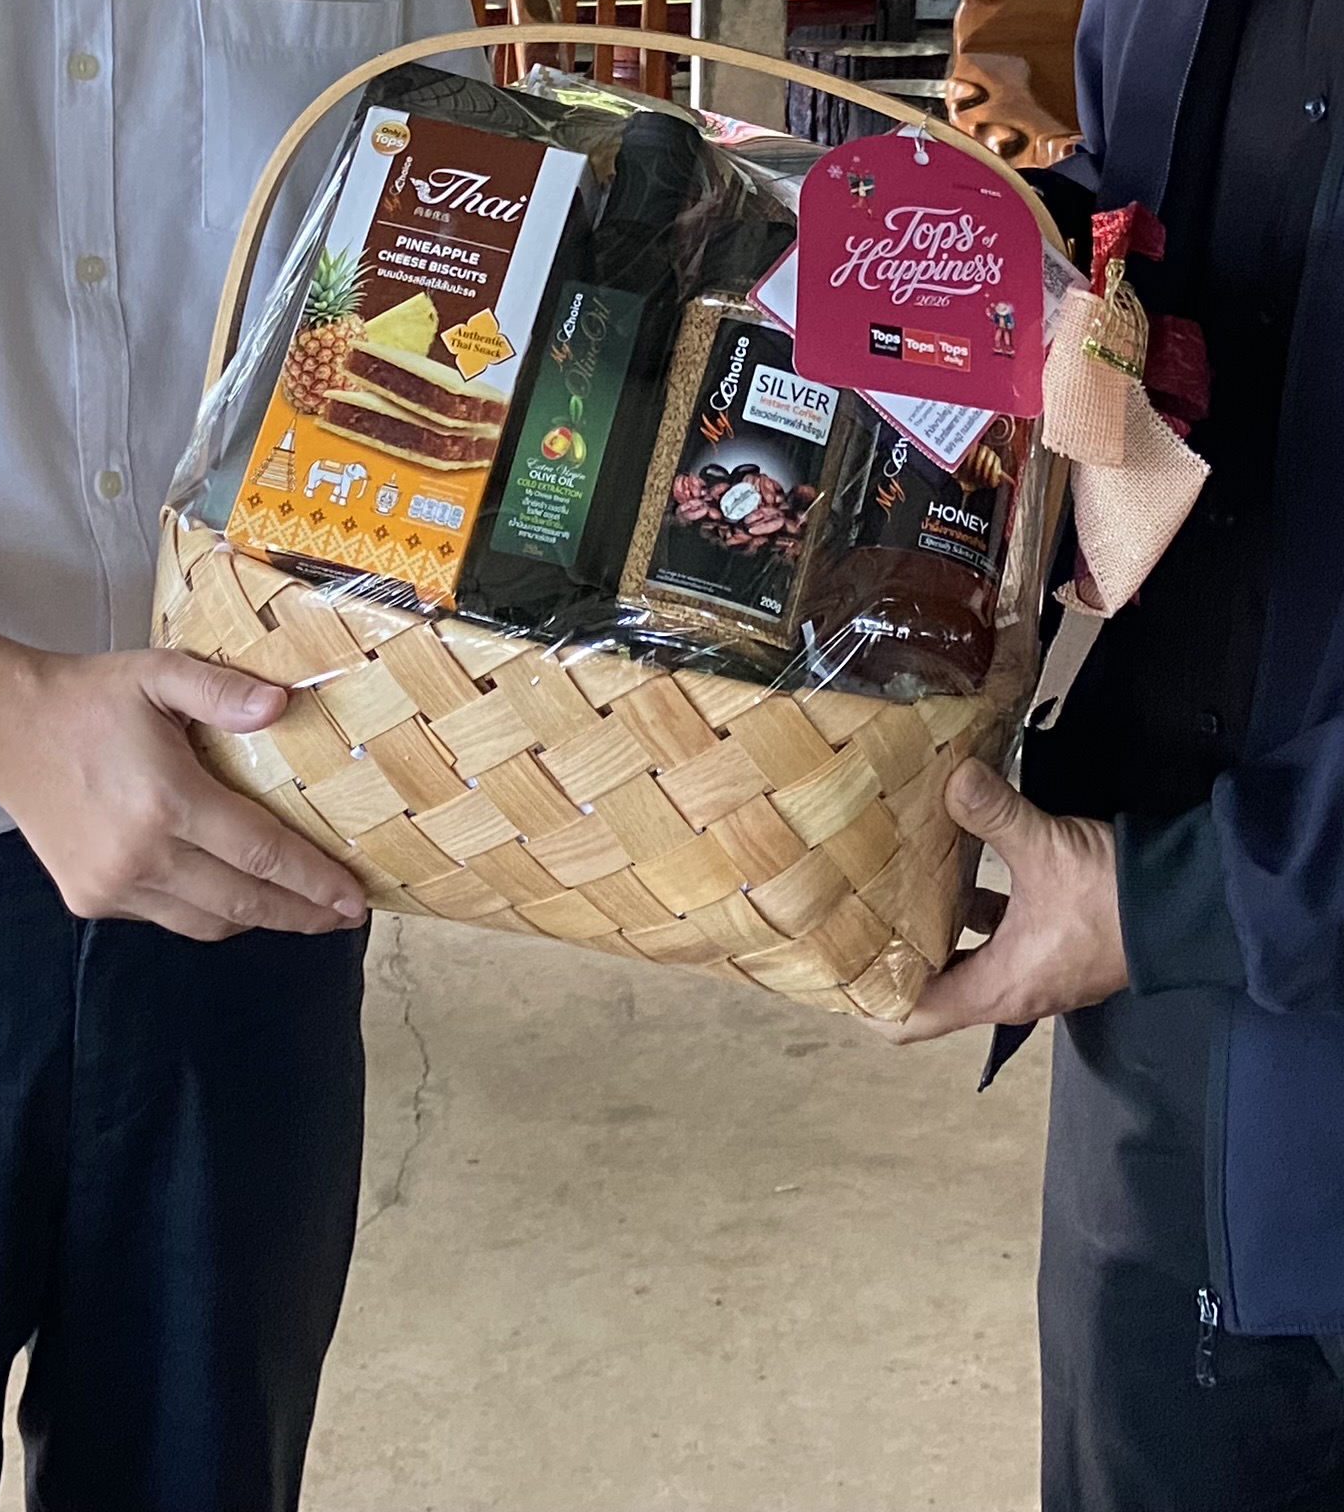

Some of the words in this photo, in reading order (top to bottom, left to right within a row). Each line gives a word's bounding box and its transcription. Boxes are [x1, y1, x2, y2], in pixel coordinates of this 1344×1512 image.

[375, 132, 405, 148] Tops
[429, 168, 528, 223] Thai
[885, 206, 986, 259] Tops
[982, 233, 998, 248] of
[395, 234, 481, 266] PINEAPPLE
[378, 249, 427, 270] CHEESE
[428, 260, 488, 285] BISCUITS
[830, 235, 1004, 305] Happiness
[913, 294, 951, 308] 2026
[557, 293, 583, 343] Choice
[580, 296, 612, 343] Oil
[450, 337, 472, 352] Thai
[472, 344, 502, 359] Snack
[454, 328, 505, 348] Authentic
[871, 329, 901, 344] Tops
[905, 338, 935, 353] Tops
[938, 341, 968, 356] Tops
[550, 342, 573, 372] My
[565, 344, 601, 399] Olive
[944, 355, 964, 366] daily
[710, 336, 750, 411] Choice
[756, 373, 830, 416] SILVER
[759, 395, 791, 413] Instant
[792, 405, 823, 423] Coffee
[700, 410, 735, 455] My
[517, 477, 537, 489] COLD
[537, 482, 583, 499] EXTRACTION
[529, 470, 557, 484] OLIVE
[558, 476, 574, 488] OIL
[875, 478, 906, 523] My
[927, 500, 989, 535] HONEY
[759, 595, 783, 615] 200g
